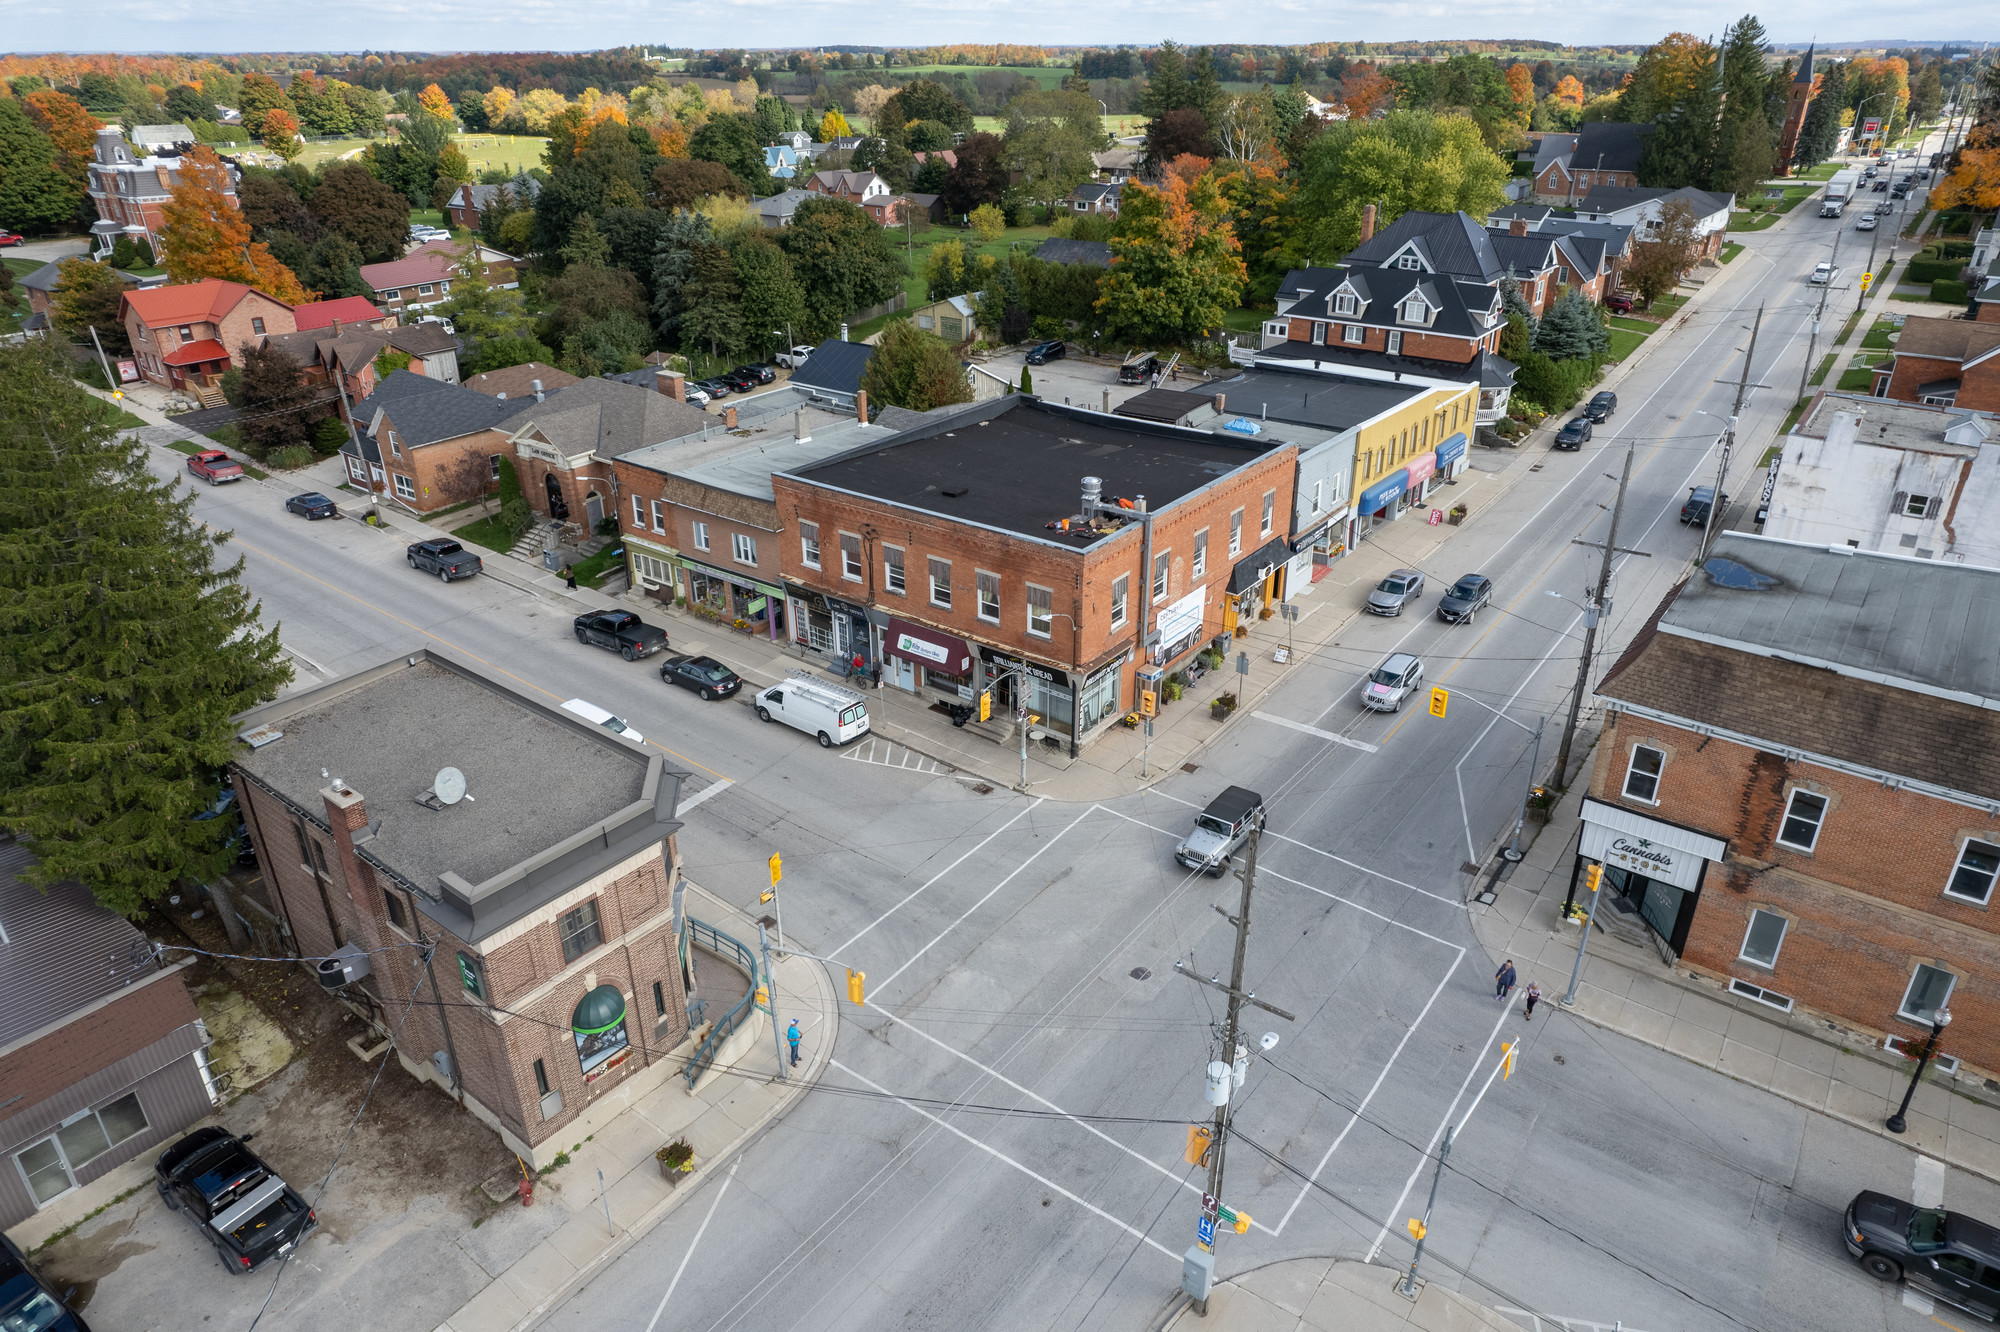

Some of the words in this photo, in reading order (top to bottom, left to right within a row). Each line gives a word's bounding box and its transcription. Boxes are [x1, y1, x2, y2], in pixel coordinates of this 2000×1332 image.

[531, 447, 540, 455] LAW
[541, 451, 555, 460] OFFICE
[849, 608, 864, 617] OFFICE
[1160, 605, 1178, 620] CENTURY
[1612, 838, 1673, 866] Cannabis
[1620, 853, 1661, 872] STOP
[491, 929, 516, 946] THE
[523, 902, 562, 930] BANK
[565, 889, 585, 906] OF
[589, 849, 653, 892] TORONTO
[1200, 1219, 1212, 1234] H
